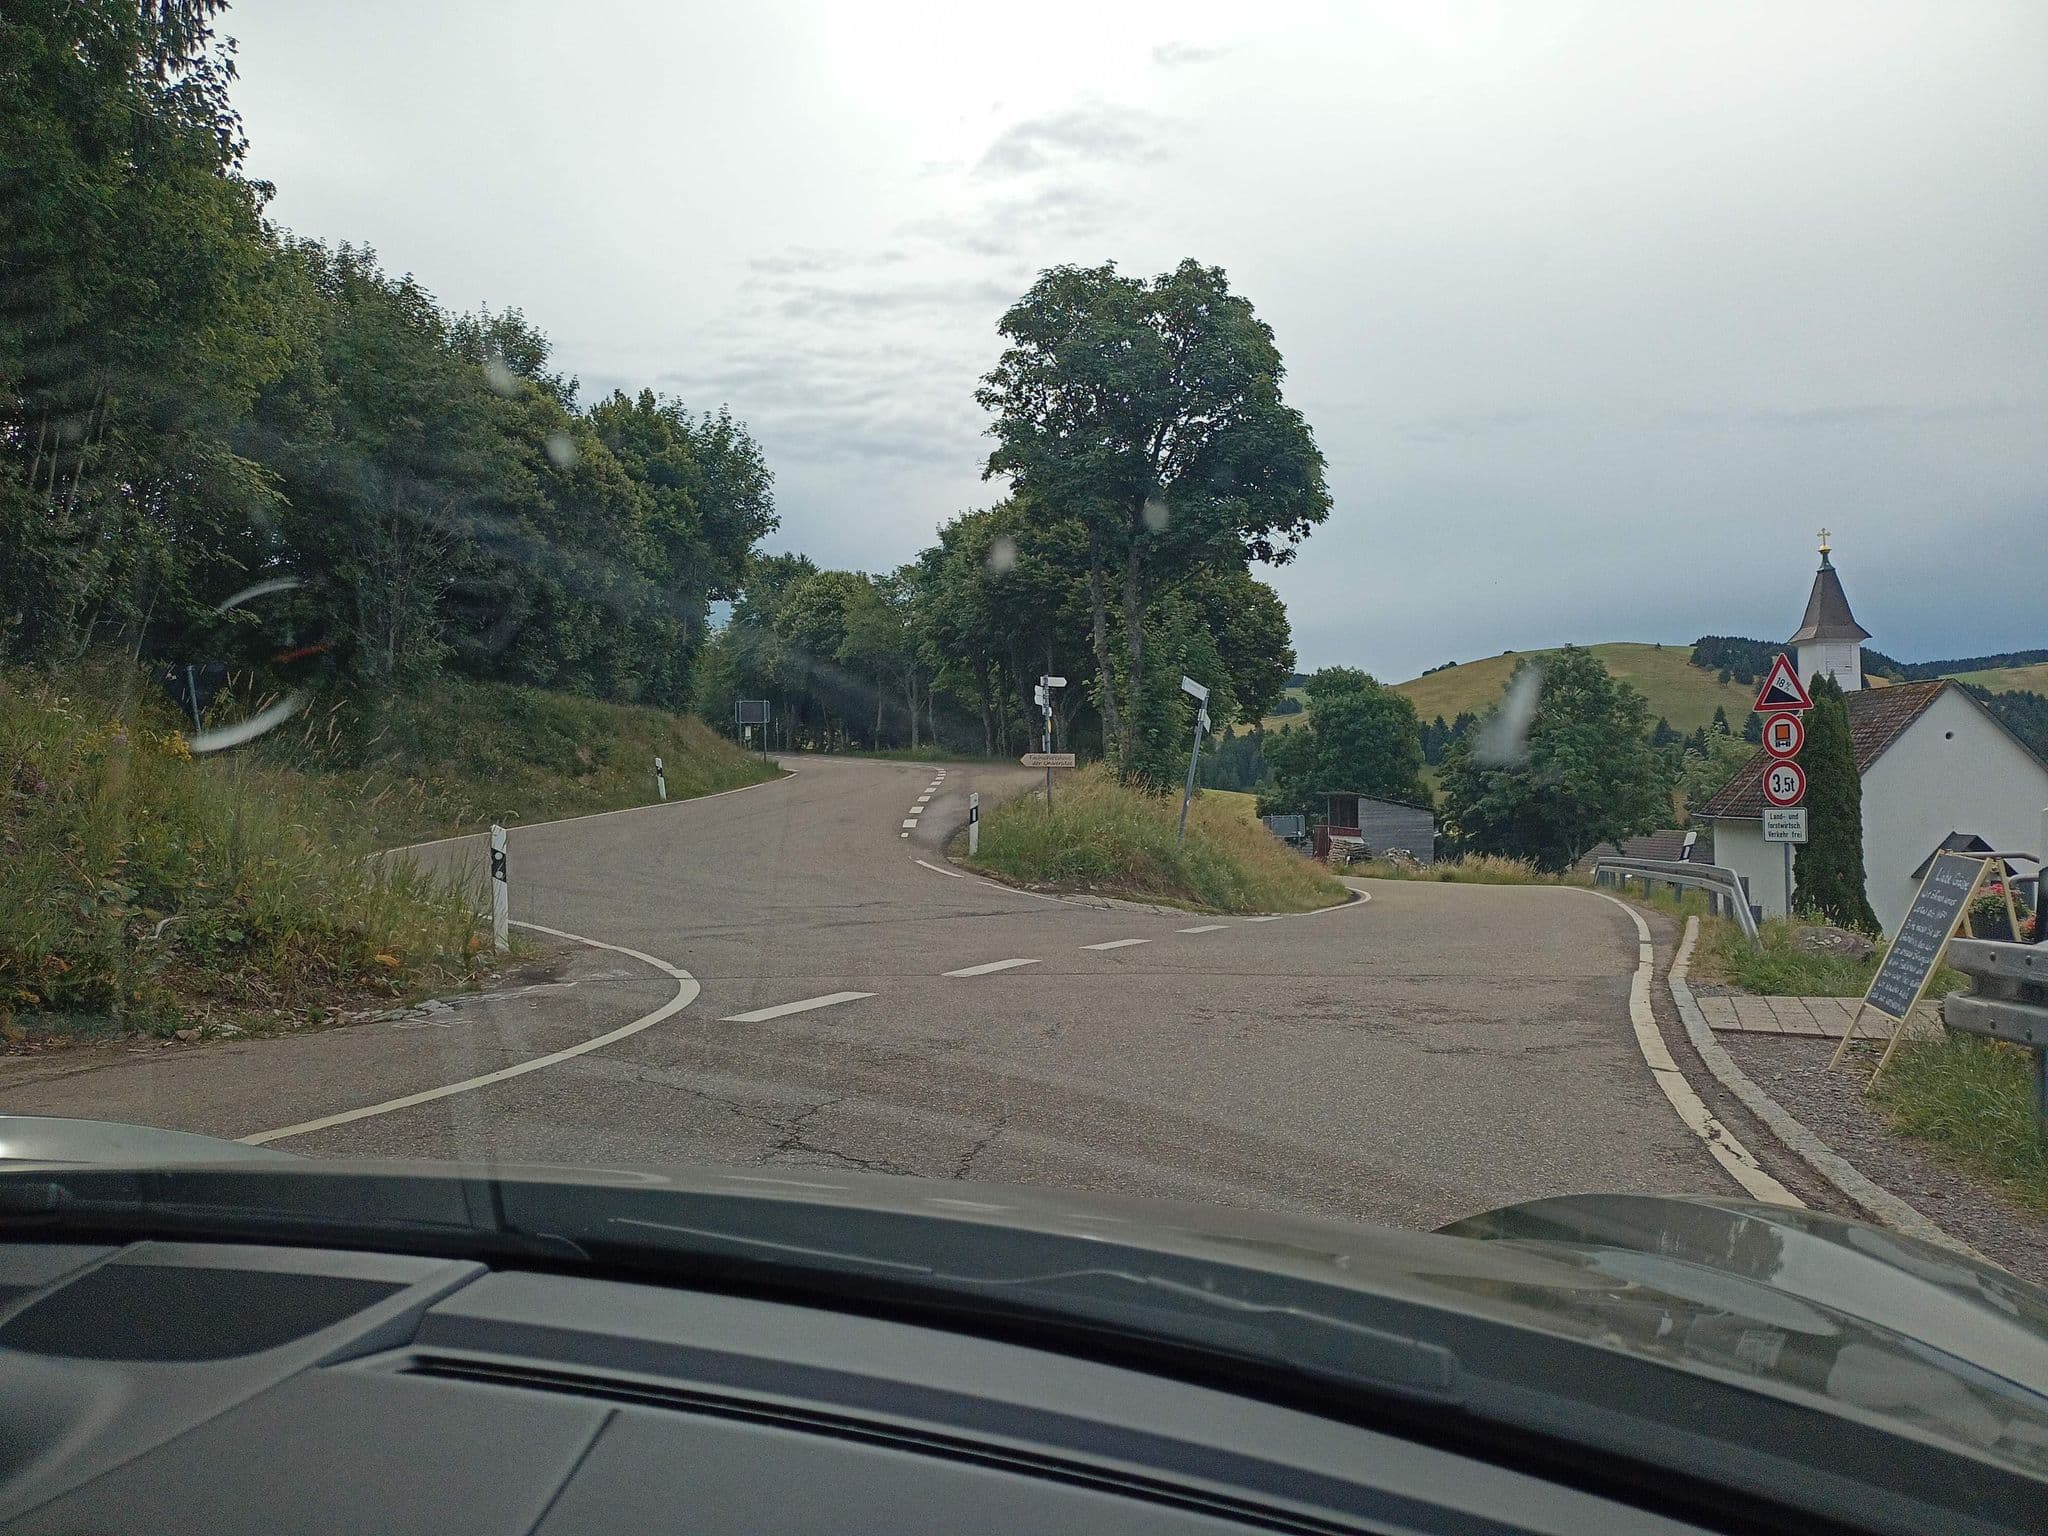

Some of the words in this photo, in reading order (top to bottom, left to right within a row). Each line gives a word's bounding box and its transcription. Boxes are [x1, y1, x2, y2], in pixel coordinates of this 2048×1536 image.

[1773, 774, 1795, 793] 3,5t
[1768, 830, 1789, 838] Verkehr
[1791, 830, 1803, 838] frei
